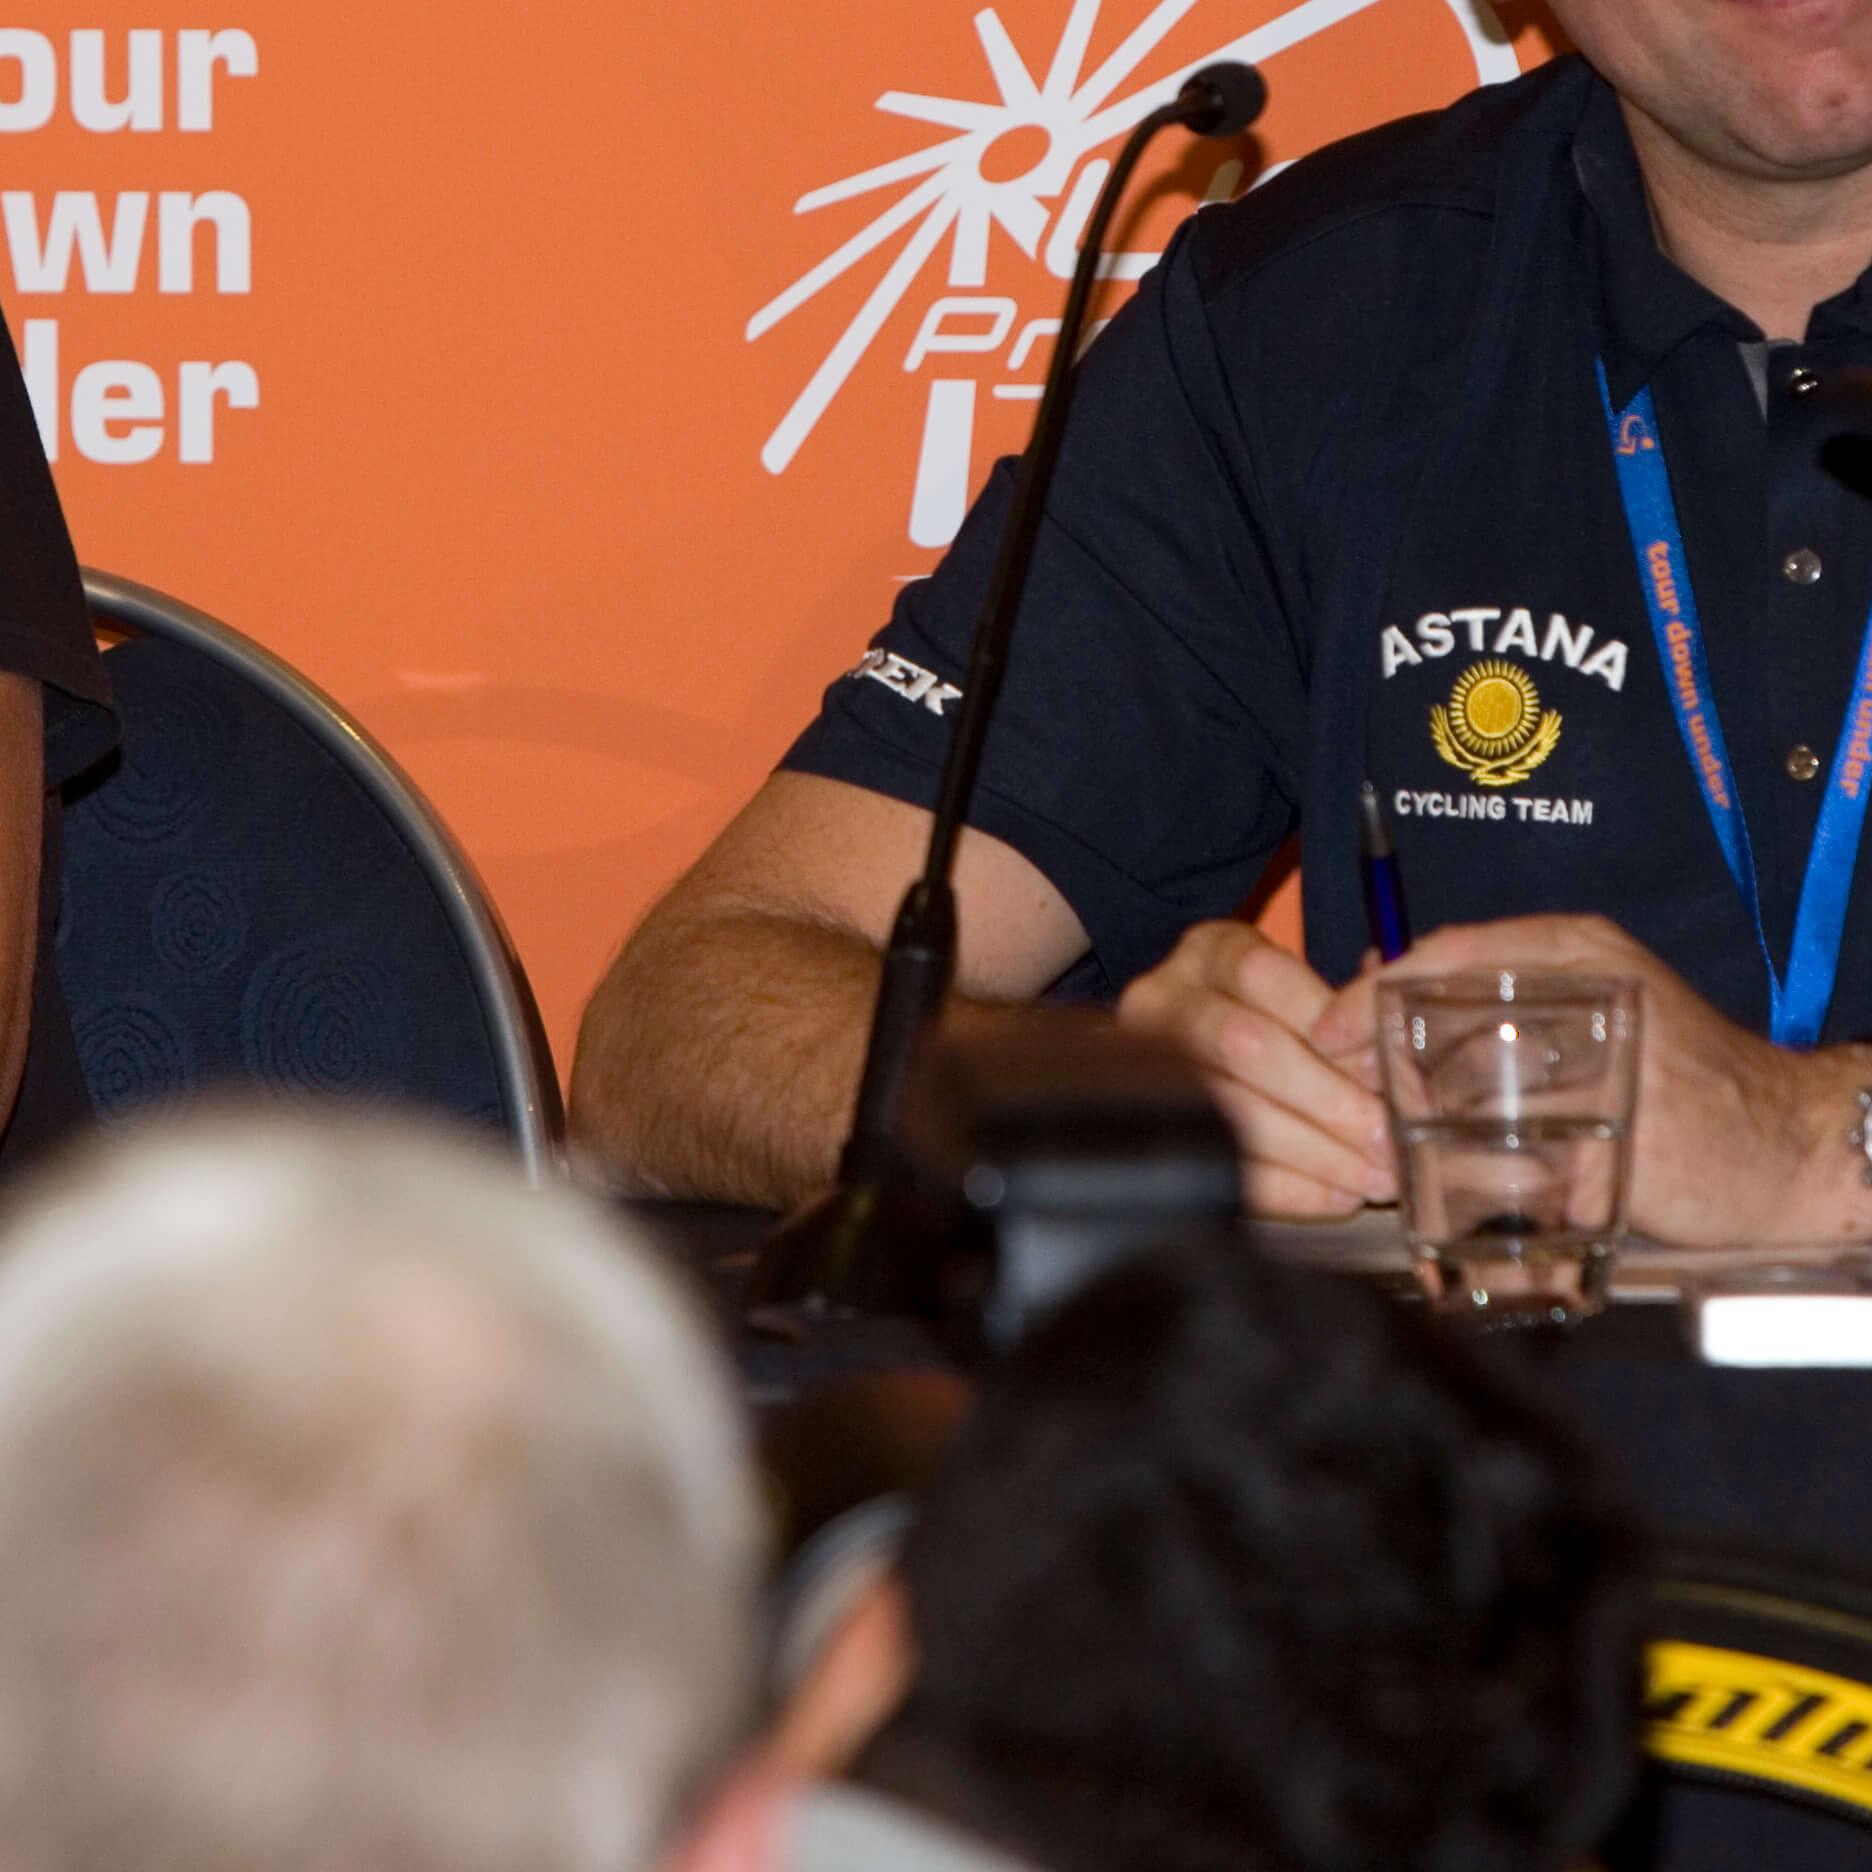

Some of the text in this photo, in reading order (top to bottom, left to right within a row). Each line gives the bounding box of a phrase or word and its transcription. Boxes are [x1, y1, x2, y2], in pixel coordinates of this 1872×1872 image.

[1381, 608, 1628, 691] ASTANA
[1647, 540, 1730, 809] tour down under
[1395, 790, 1593, 826] CYCLING TEAM
